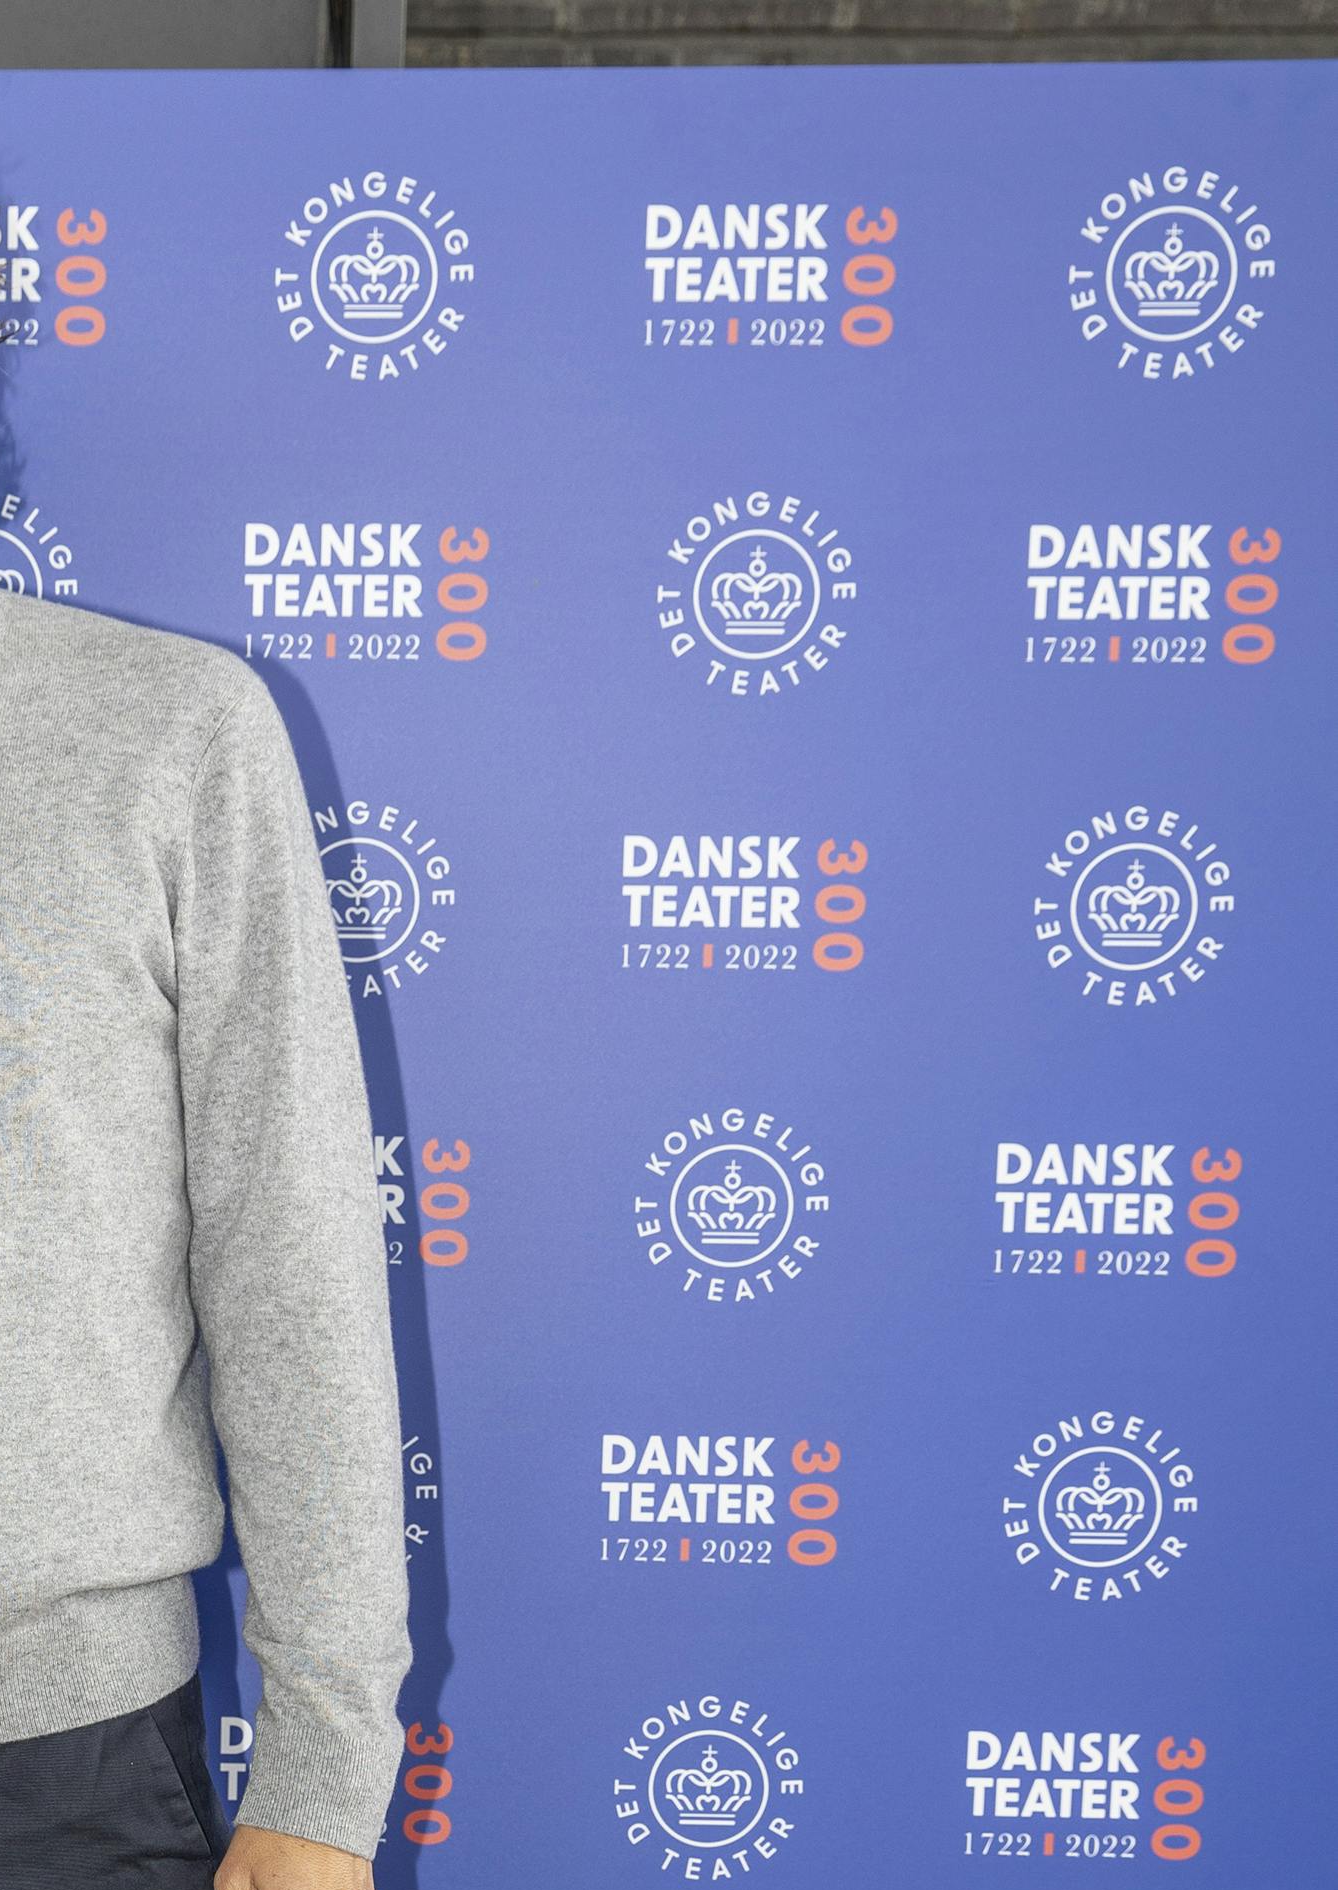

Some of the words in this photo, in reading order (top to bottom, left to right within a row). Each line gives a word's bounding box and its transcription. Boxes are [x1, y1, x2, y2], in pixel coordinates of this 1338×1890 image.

[284, 171, 475, 282] KONGELIGE
[645, 203, 829, 251] DANSK
[1080, 165, 1276, 278] KONGELIGE
[54, 207, 108, 347] 300
[274, 267, 315, 343] DET
[644, 256, 829, 303] TEATER
[839, 205, 899, 348] 300
[1068, 264, 1108, 341] DET
[325, 307, 465, 381] TEATER
[645, 318, 715, 346] 1722
[750, 318, 825, 346] 2022
[1117, 303, 1265, 380] TEATER
[244, 522, 423, 568] DANSK
[667, 490, 857, 600] KONGELIGE
[1027, 523, 1213, 570] DANSK
[244, 573, 423, 618] TEATER
[435, 526, 490, 662] 300
[656, 584, 696, 658] DET
[1026, 575, 1211, 621] TEATER
[1221, 526, 1283, 665] 300
[245, 633, 313, 660] 1722
[348, 633, 421, 661] 2022
[706, 623, 847, 696] TEATER
[1026, 636, 1097, 663] 1722
[1132, 636, 1207, 664] 2022
[315, 800, 455, 906] NGELIGE
[622, 834, 801, 880] DANSK
[621, 884, 801, 929] TEATER
[812, 837, 869, 972] 300
[621, 943, 690, 969] 1722
[725, 944, 798, 970] 2022
[644, 1107, 830, 1212] KONGELIGE
[995, 1142, 1176, 1187] DANSK
[419, 1138, 471, 1267] 300
[634, 1196, 673, 1266] DET
[994, 1191, 1174, 1236] TEATER
[1184, 1146, 1243, 1279] 300
[683, 1235, 820, 1303] TEATER
[993, 1249, 1063, 1275] 1722
[1097, 1250, 1171, 1276] 2022
[1013, 1410, 1199, 1513] KONGELIGE
[1002, 1496, 1041, 1565] DET
[1049, 1535, 1188, 1602] TEATER
[403, 1721, 454, 1846] 300
[965, 1730, 1141, 1774] DANSK
[965, 1776, 1140, 1820] TEATER
[1149, 1735, 1207, 1862] 300
[964, 1831, 1032, 1857] 1722
[1065, 1833, 1137, 1859] 2022
